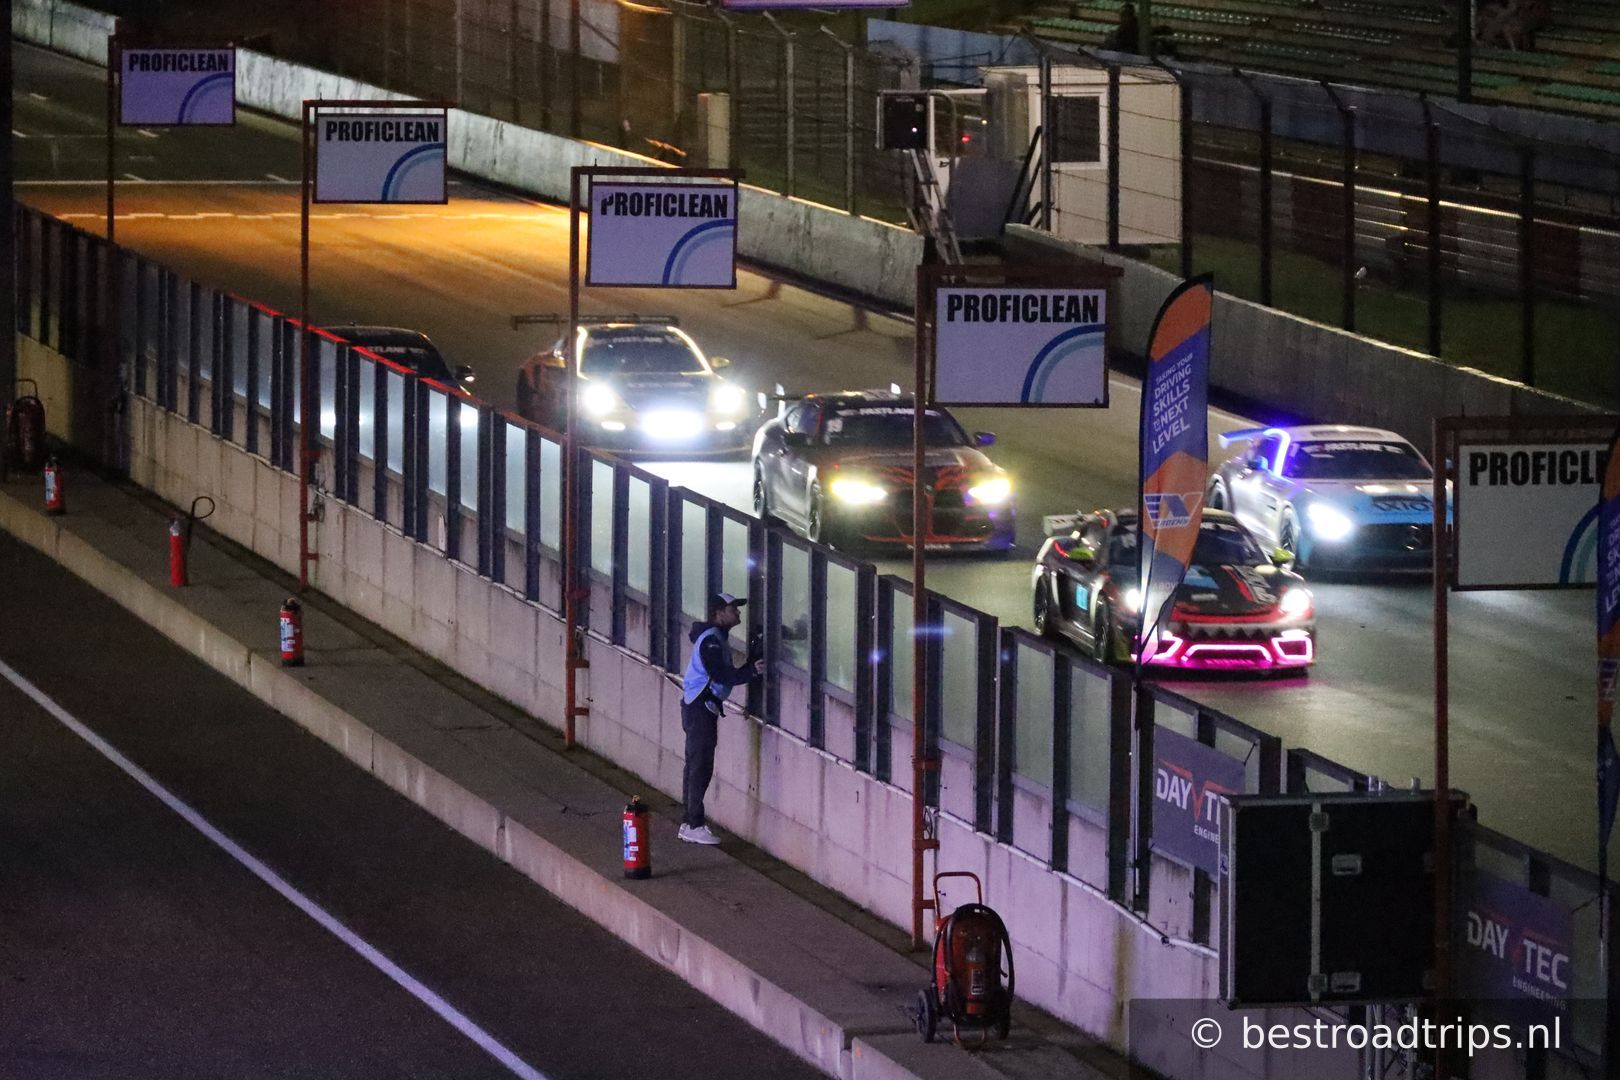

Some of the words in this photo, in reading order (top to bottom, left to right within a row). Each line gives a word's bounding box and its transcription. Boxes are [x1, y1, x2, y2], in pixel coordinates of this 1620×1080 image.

[128, 53, 229, 72] PROFICLEAN
[325, 120, 440, 142] PROFICLEAN
[600, 191, 729, 219] PROFICLEAN
[947, 293, 1099, 324] PROFICLEAN
[1154, 363, 1193, 400] DRIVING
[1152, 378, 1191, 417] SKILLS
[1160, 395, 1190, 427] NEXT
[1152, 416, 1192, 455] LEVEL
